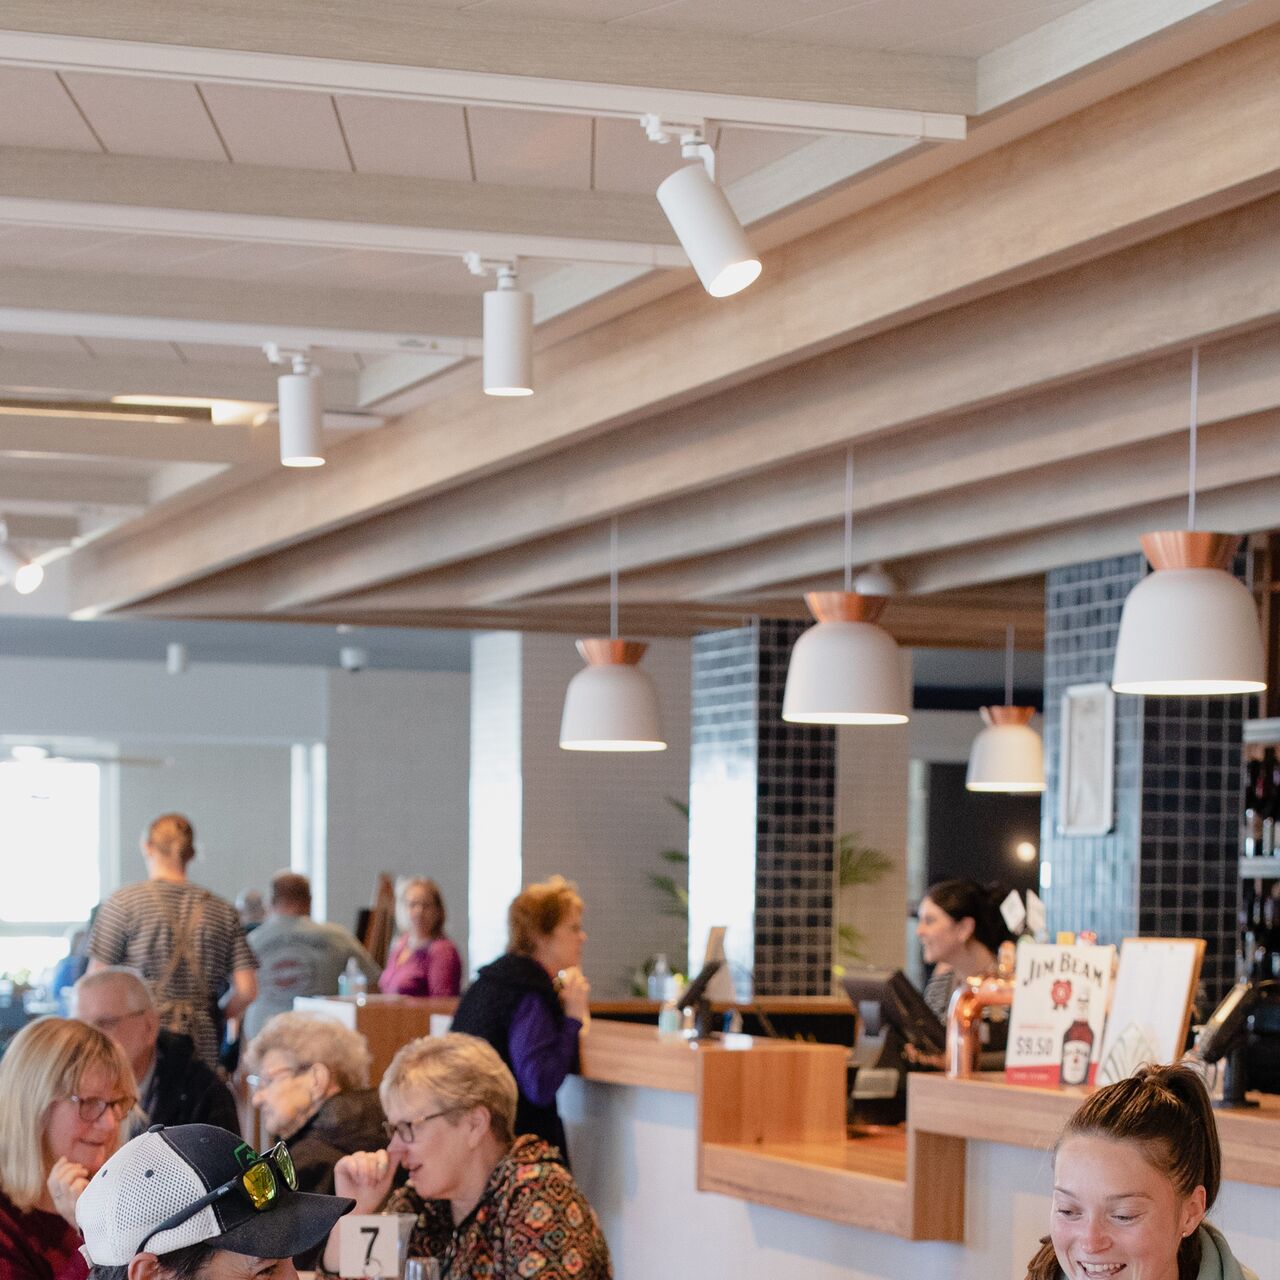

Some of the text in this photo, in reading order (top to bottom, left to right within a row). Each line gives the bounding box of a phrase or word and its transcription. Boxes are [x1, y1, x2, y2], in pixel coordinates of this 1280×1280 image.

[1022, 951, 1104, 988] JIM BEAM
[360, 1227, 380, 1266] 7
